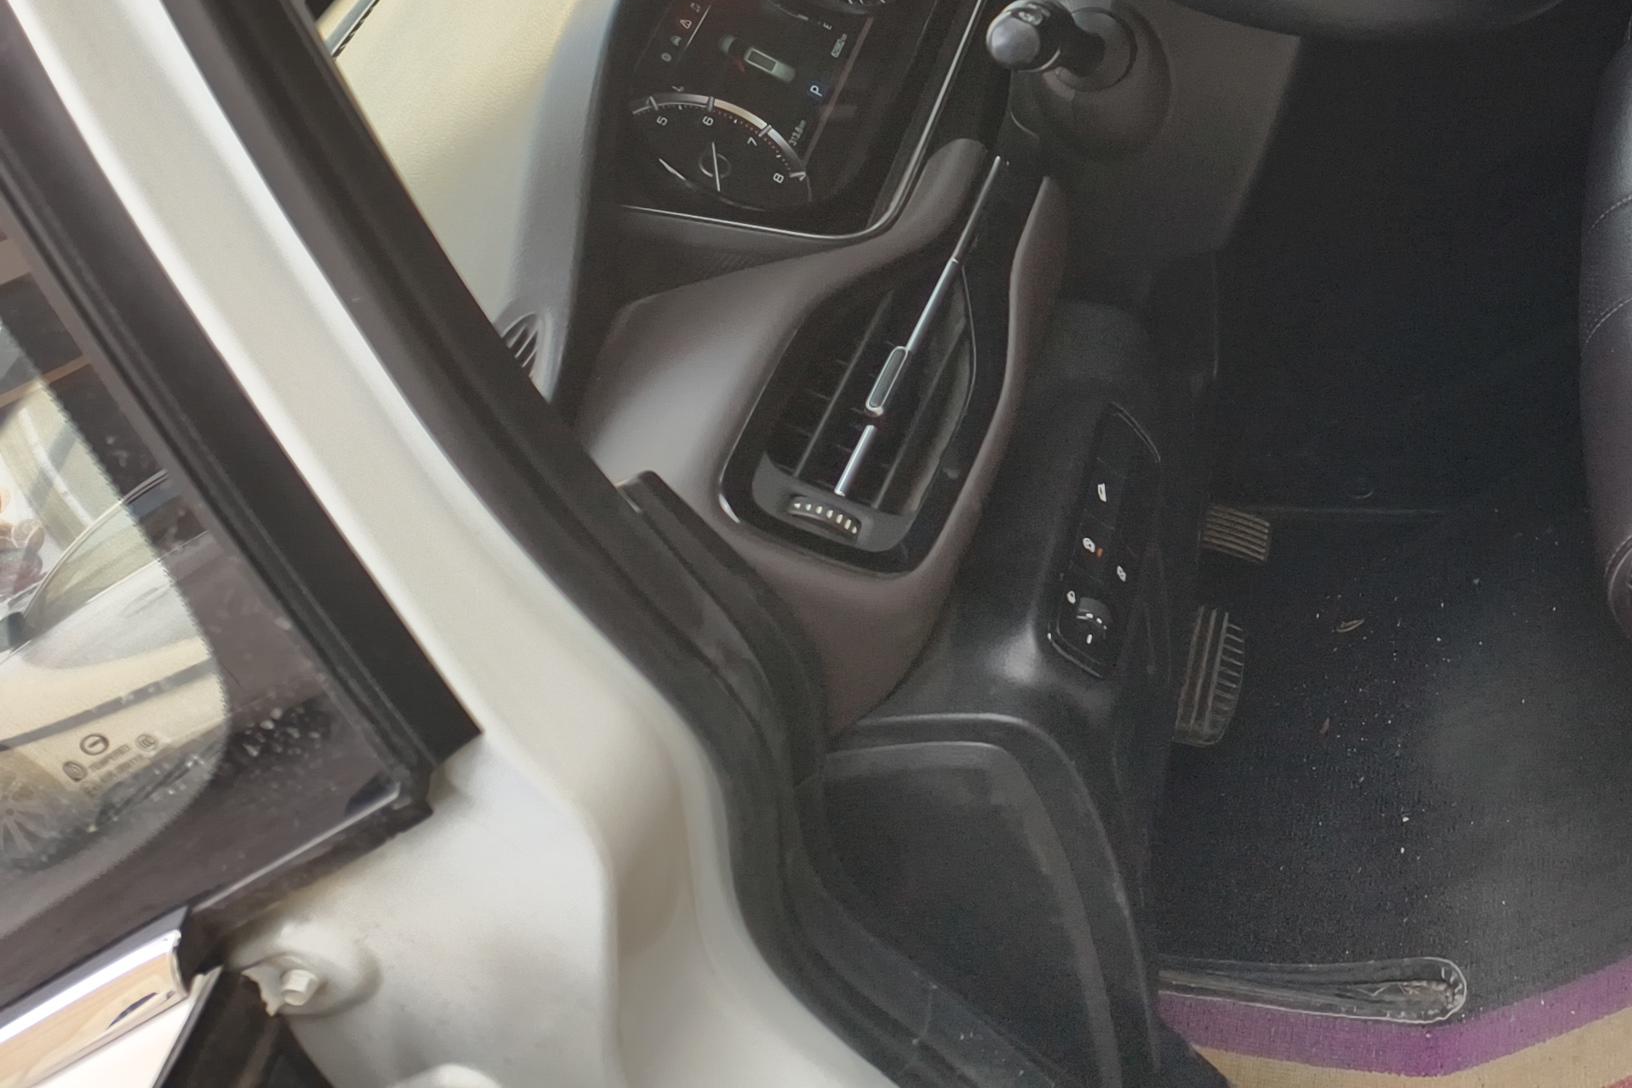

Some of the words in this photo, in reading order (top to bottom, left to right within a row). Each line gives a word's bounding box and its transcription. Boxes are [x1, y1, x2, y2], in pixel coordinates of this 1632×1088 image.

[809, 84, 823, 97] P
[656, 116, 668, 126] 5
[702, 116, 714, 126] 6
[746, 136, 758, 147] 7
[773, 172, 785, 184] 8
